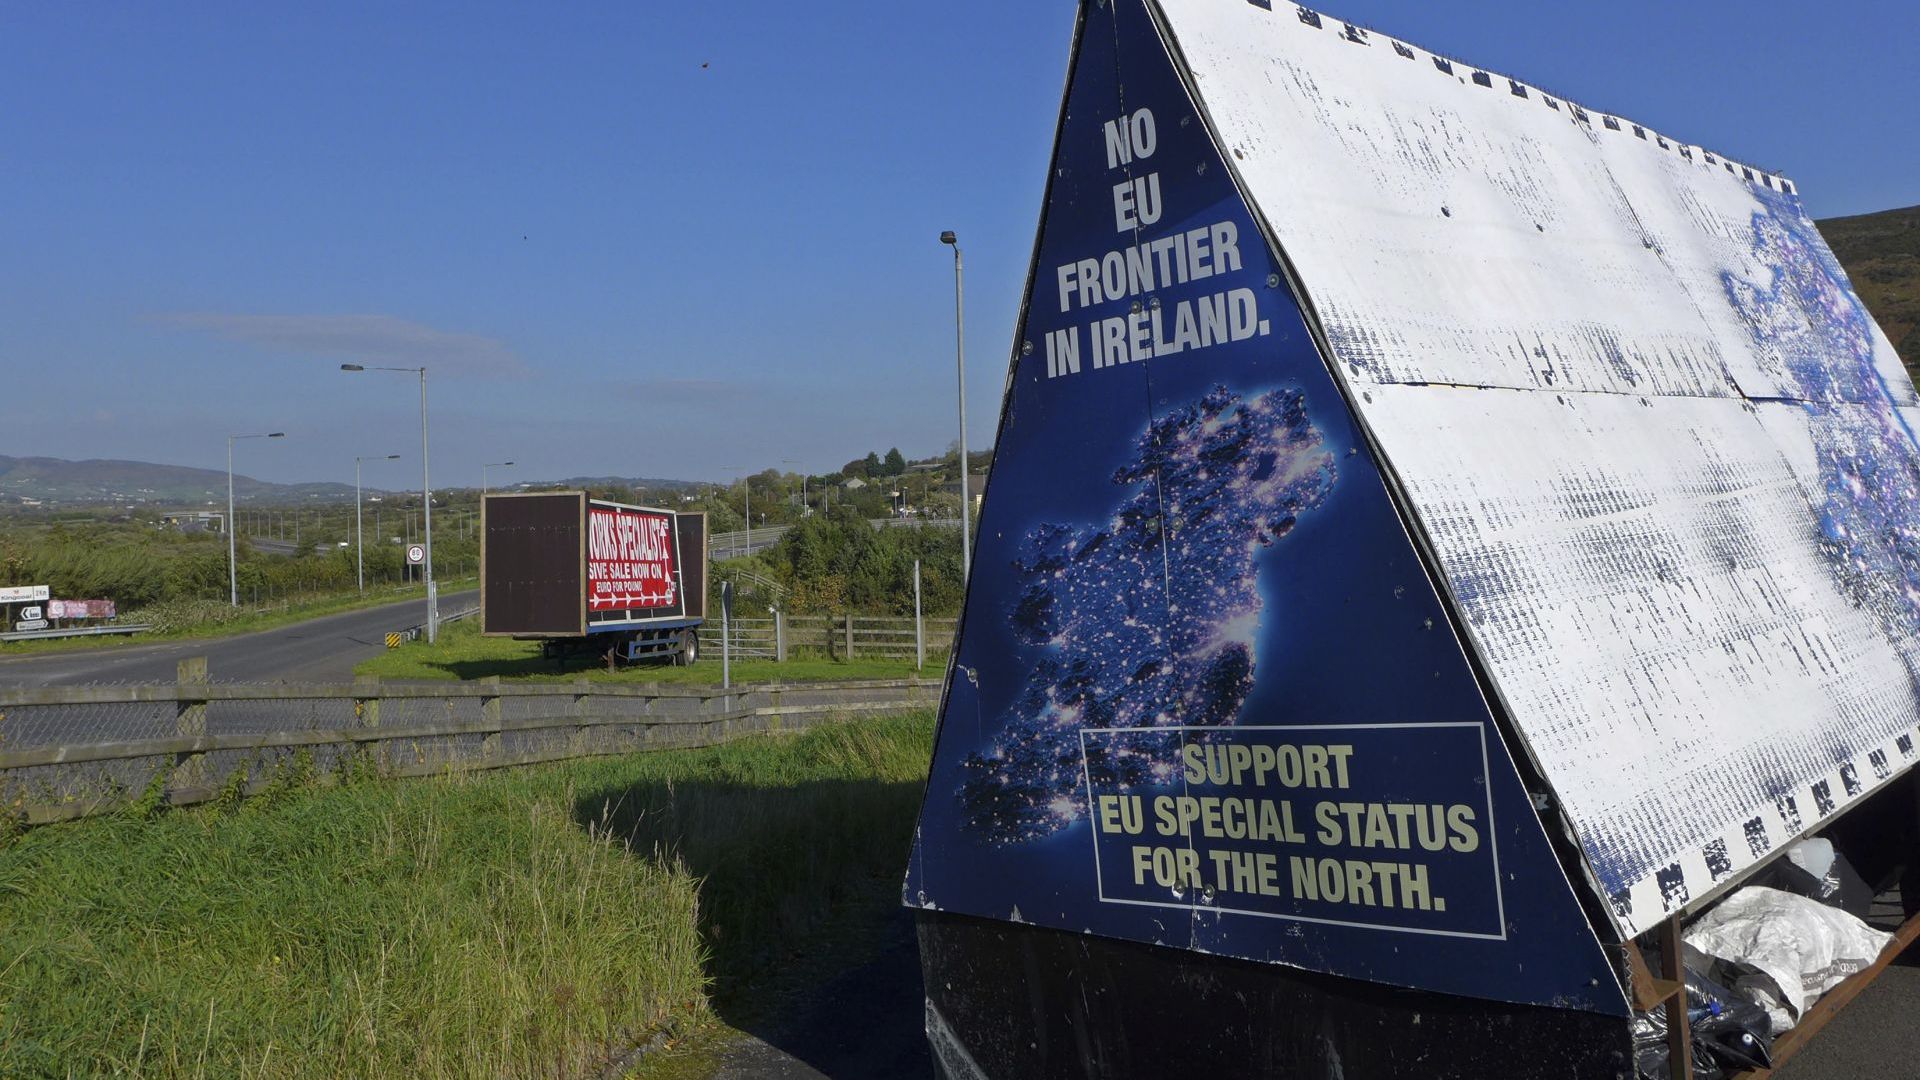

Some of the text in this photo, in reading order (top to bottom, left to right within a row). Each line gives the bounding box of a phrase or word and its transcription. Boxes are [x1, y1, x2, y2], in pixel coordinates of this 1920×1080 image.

[1104, 107, 1157, 170] NO
[1112, 172, 1163, 233] EU
[1057, 220, 1243, 313] FRONTIER
[1045, 287, 1270, 379] IN IRELAND.
[616, 514, 663, 561] SPECIALIST
[597, 581, 642, 593] EURO FOR POUND
[609, 562, 630, 579] SALE
[632, 563, 650, 579] NOW
[652, 563, 662, 579] ON
[1183, 743, 1353, 789] SUPPORT
[1098, 794, 1479, 853] EU SPECIAL STATUS
[1132, 846, 1446, 912] FOR THE NORTH.
